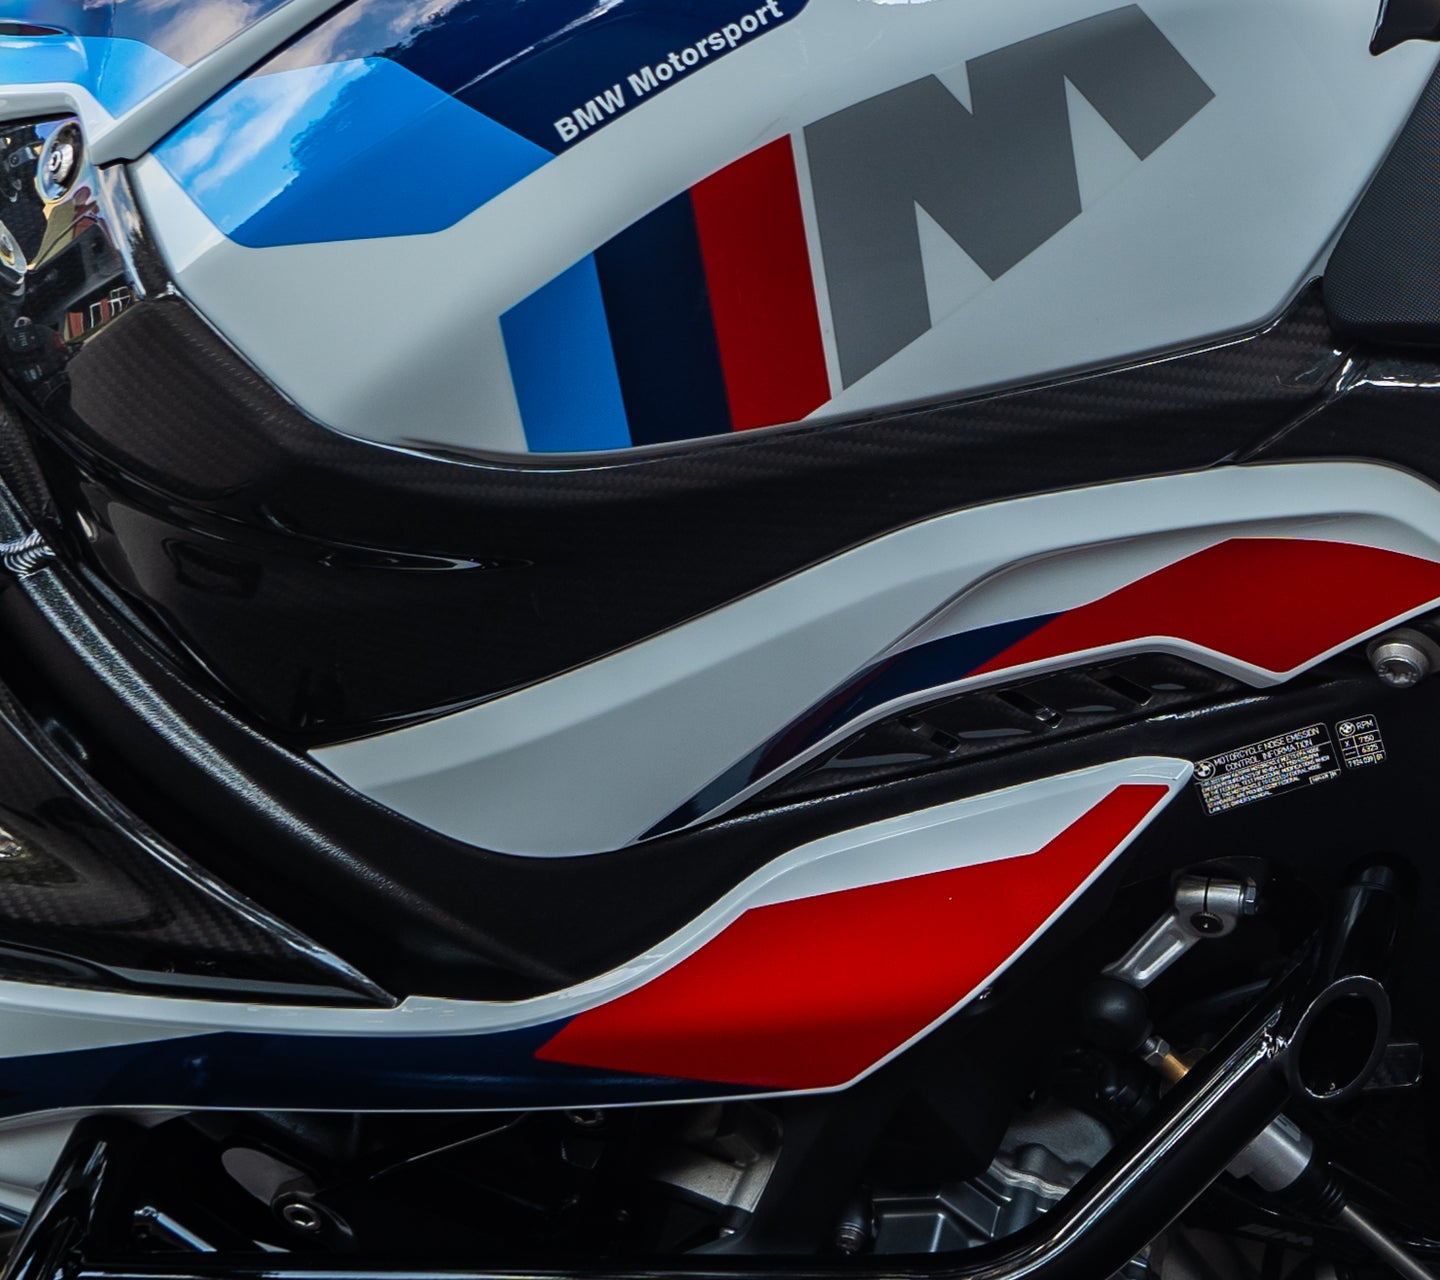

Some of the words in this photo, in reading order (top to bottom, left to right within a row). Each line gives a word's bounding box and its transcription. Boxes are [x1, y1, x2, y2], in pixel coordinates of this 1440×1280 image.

[553, 84, 626, 143] BMW
[803, 4, 1216, 390] M
[1356, 719, 1374, 730] RPM
[1213, 744, 1264, 766] MOTORCYCLE
[1263, 736, 1286, 750] NOISE
[1286, 727, 1320, 744] EMISSION
[1225, 755, 1261, 772] CONTROL
[1261, 738, 1313, 760] INFORMATION
